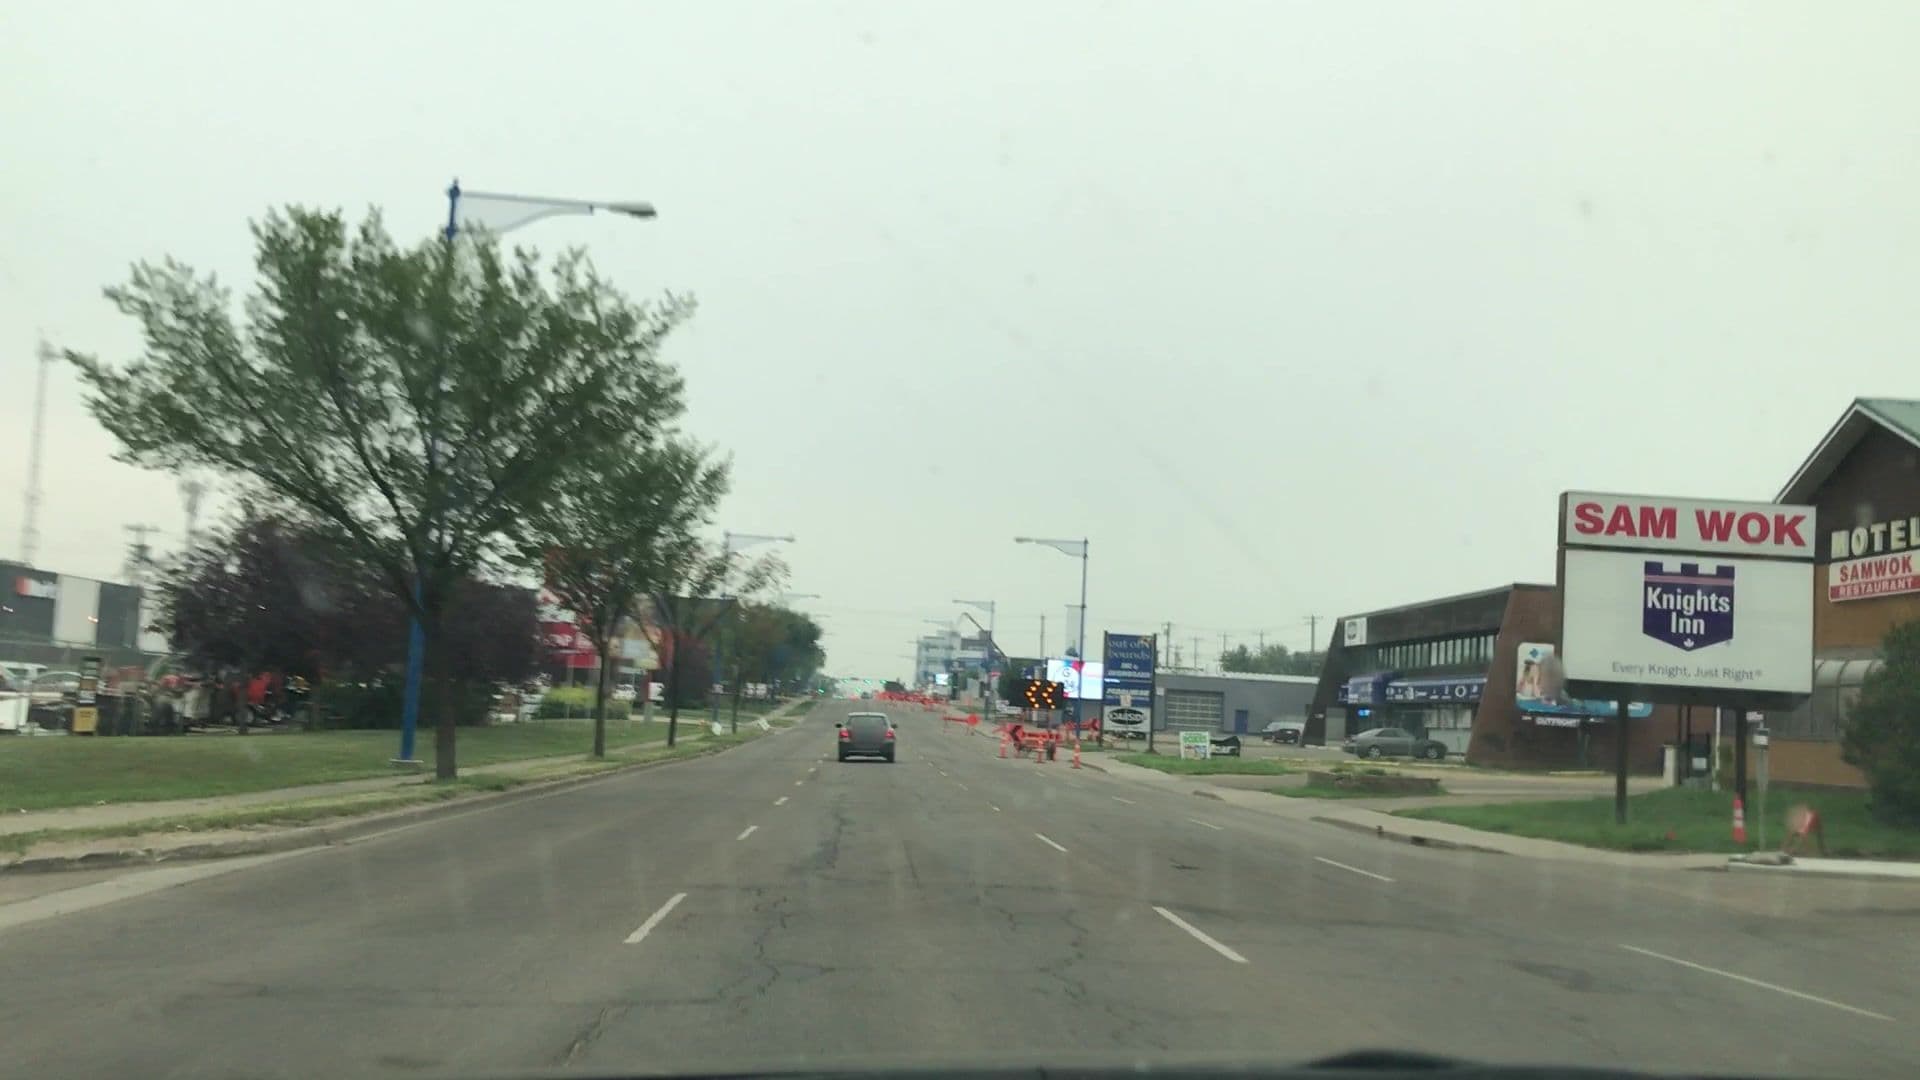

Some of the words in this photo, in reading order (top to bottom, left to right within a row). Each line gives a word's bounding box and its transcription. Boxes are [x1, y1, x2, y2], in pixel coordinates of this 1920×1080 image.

[1575, 502, 1677, 539] SAM
[1696, 509, 1807, 547] WOK
[1840, 554, 1912, 582] SAMWOK
[1839, 577, 1912, 598] RESTAURANT
[1646, 586, 1731, 616] Knights
[1670, 611, 1705, 636] Inn
[1612, 662, 1644, 676] Every
[1648, 664, 1691, 678] Knight,
[1694, 666, 1718, 678] Just
